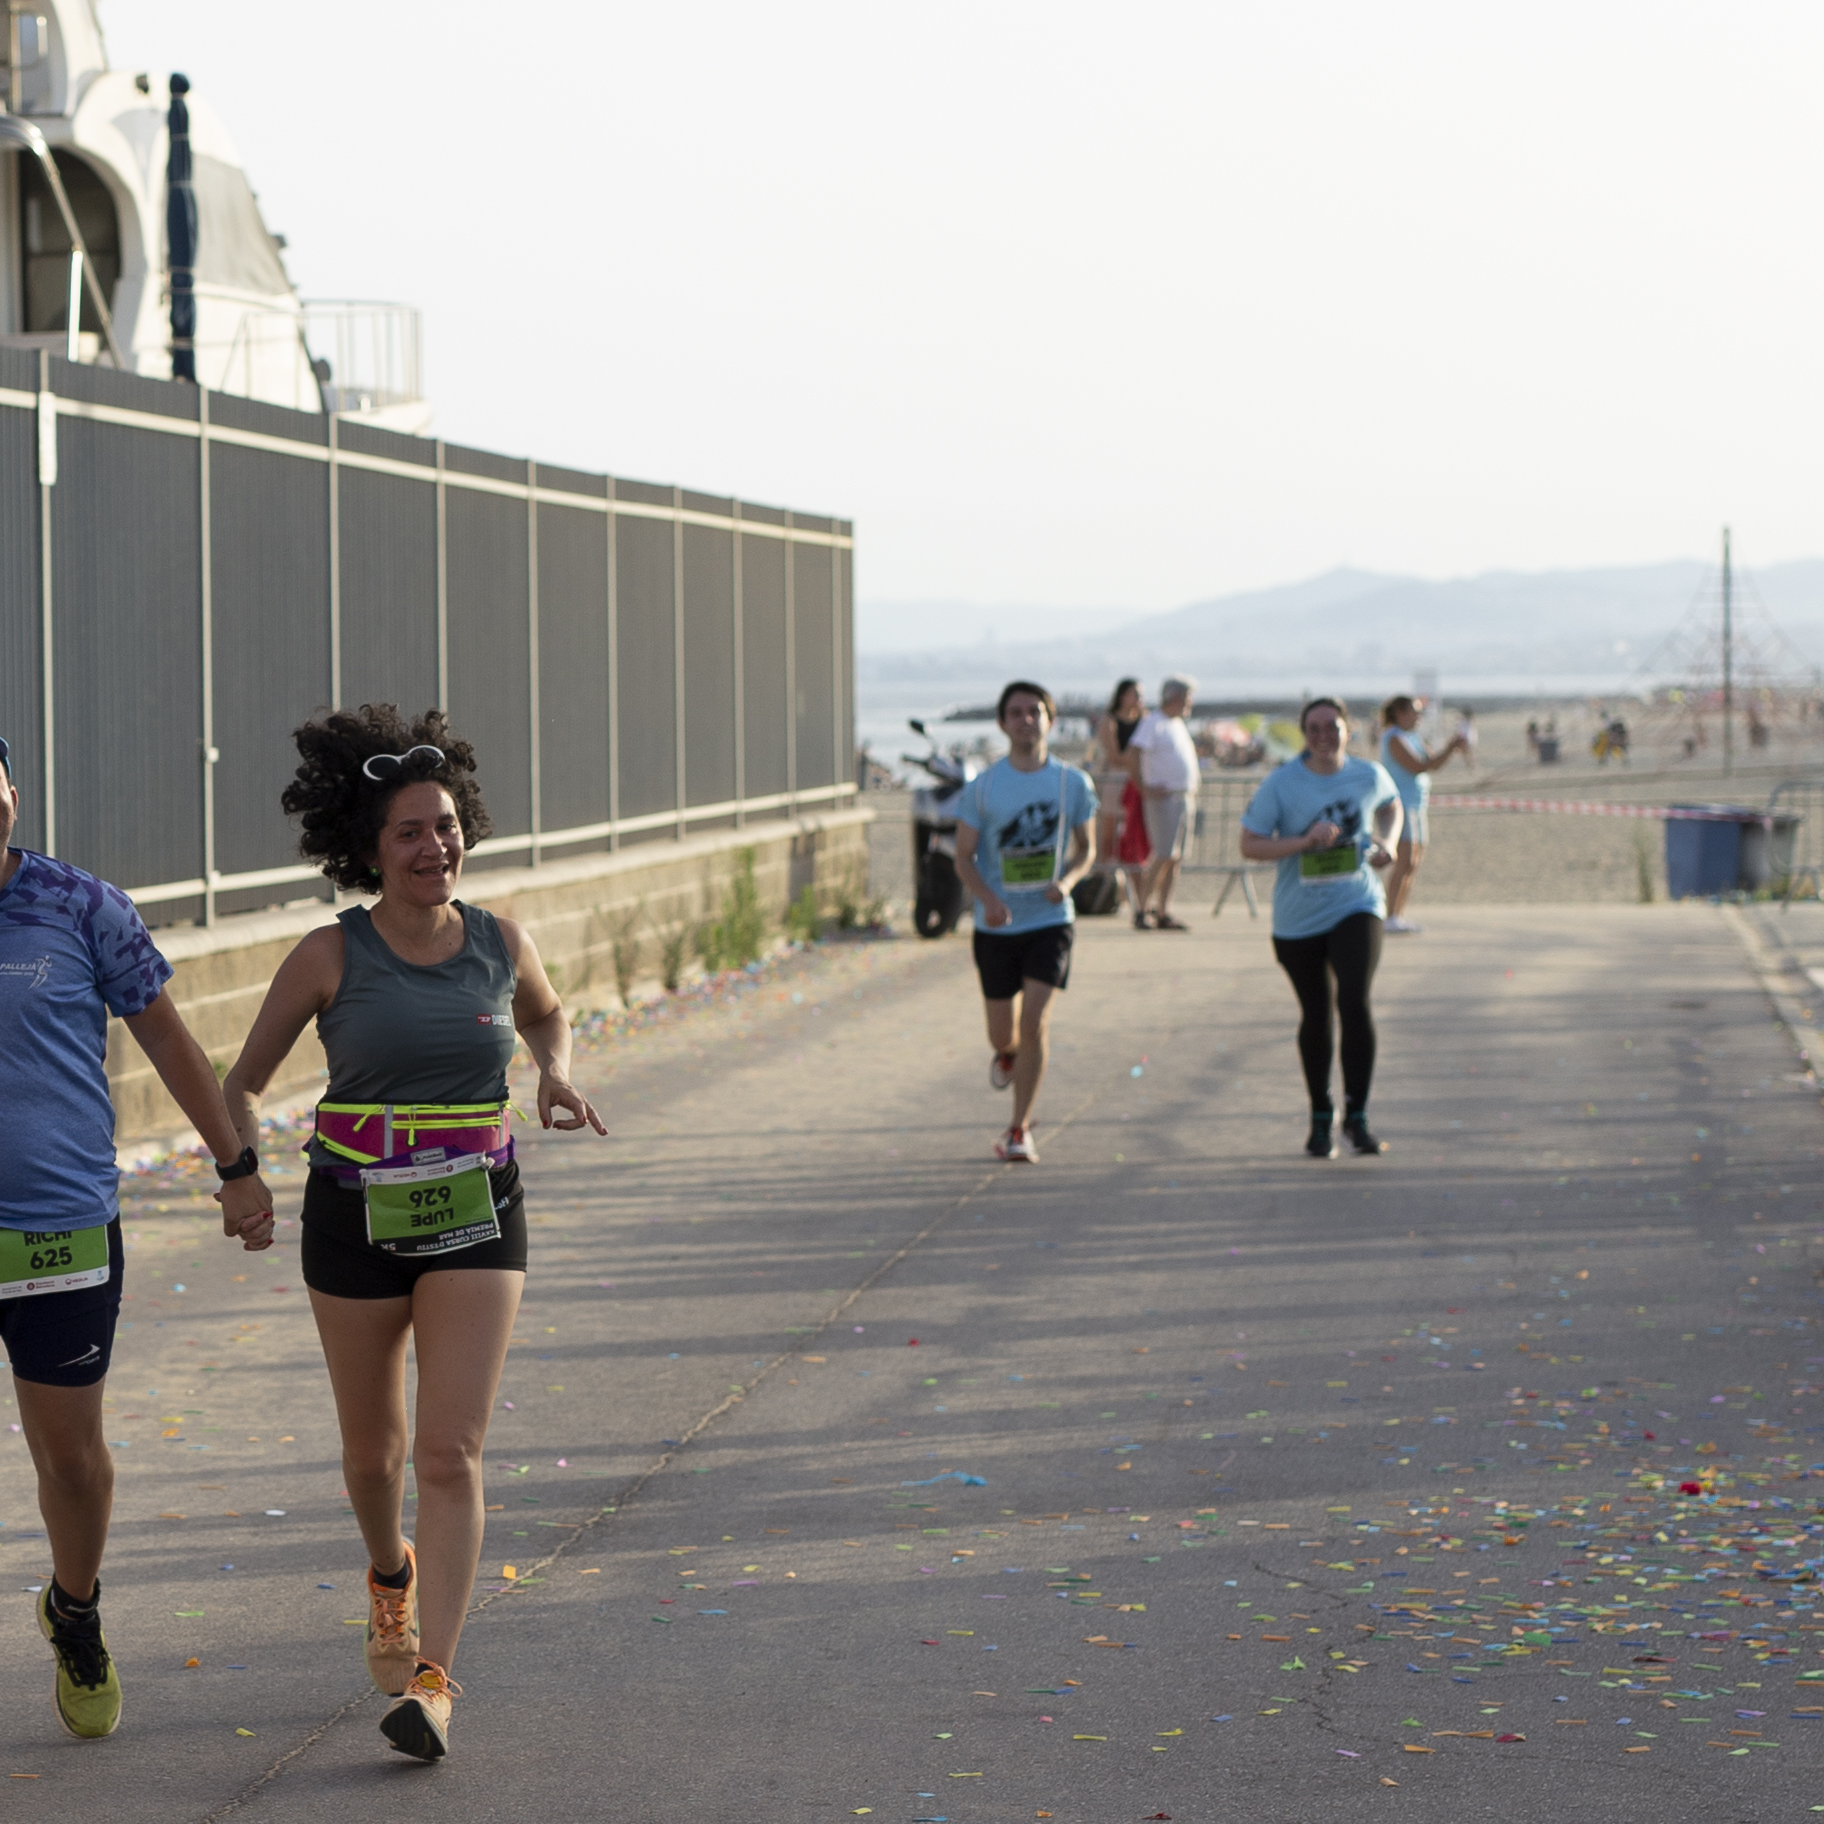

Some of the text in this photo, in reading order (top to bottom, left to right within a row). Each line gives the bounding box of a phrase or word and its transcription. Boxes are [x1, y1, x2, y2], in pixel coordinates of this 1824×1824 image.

[409, 1185, 452, 1208] 626
[410, 1207, 454, 1228] LUPE
[30, 1246, 73, 1270] 625
